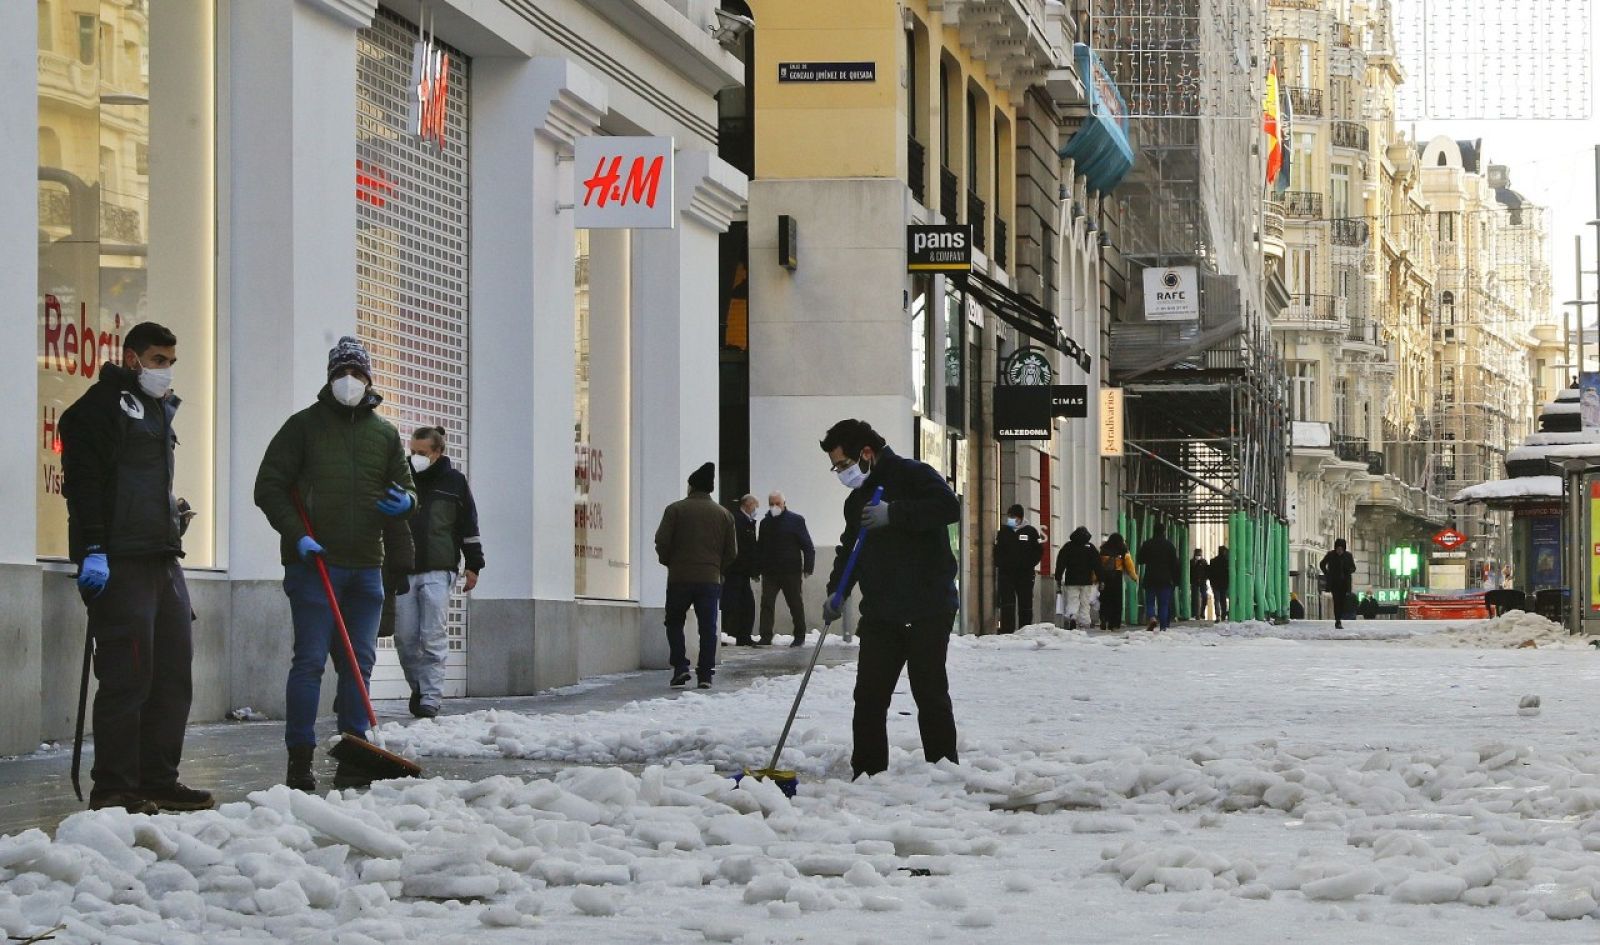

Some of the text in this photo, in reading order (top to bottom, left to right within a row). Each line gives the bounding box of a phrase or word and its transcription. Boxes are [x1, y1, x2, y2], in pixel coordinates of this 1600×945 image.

[789, 71, 814, 80] GONZALO
[839, 71, 846, 80] DE
[849, 71, 873, 80] QUESADA
[583, 156, 665, 208] H&M
[914, 232, 965, 254] pans
[935, 251, 965, 262] COMPANY
